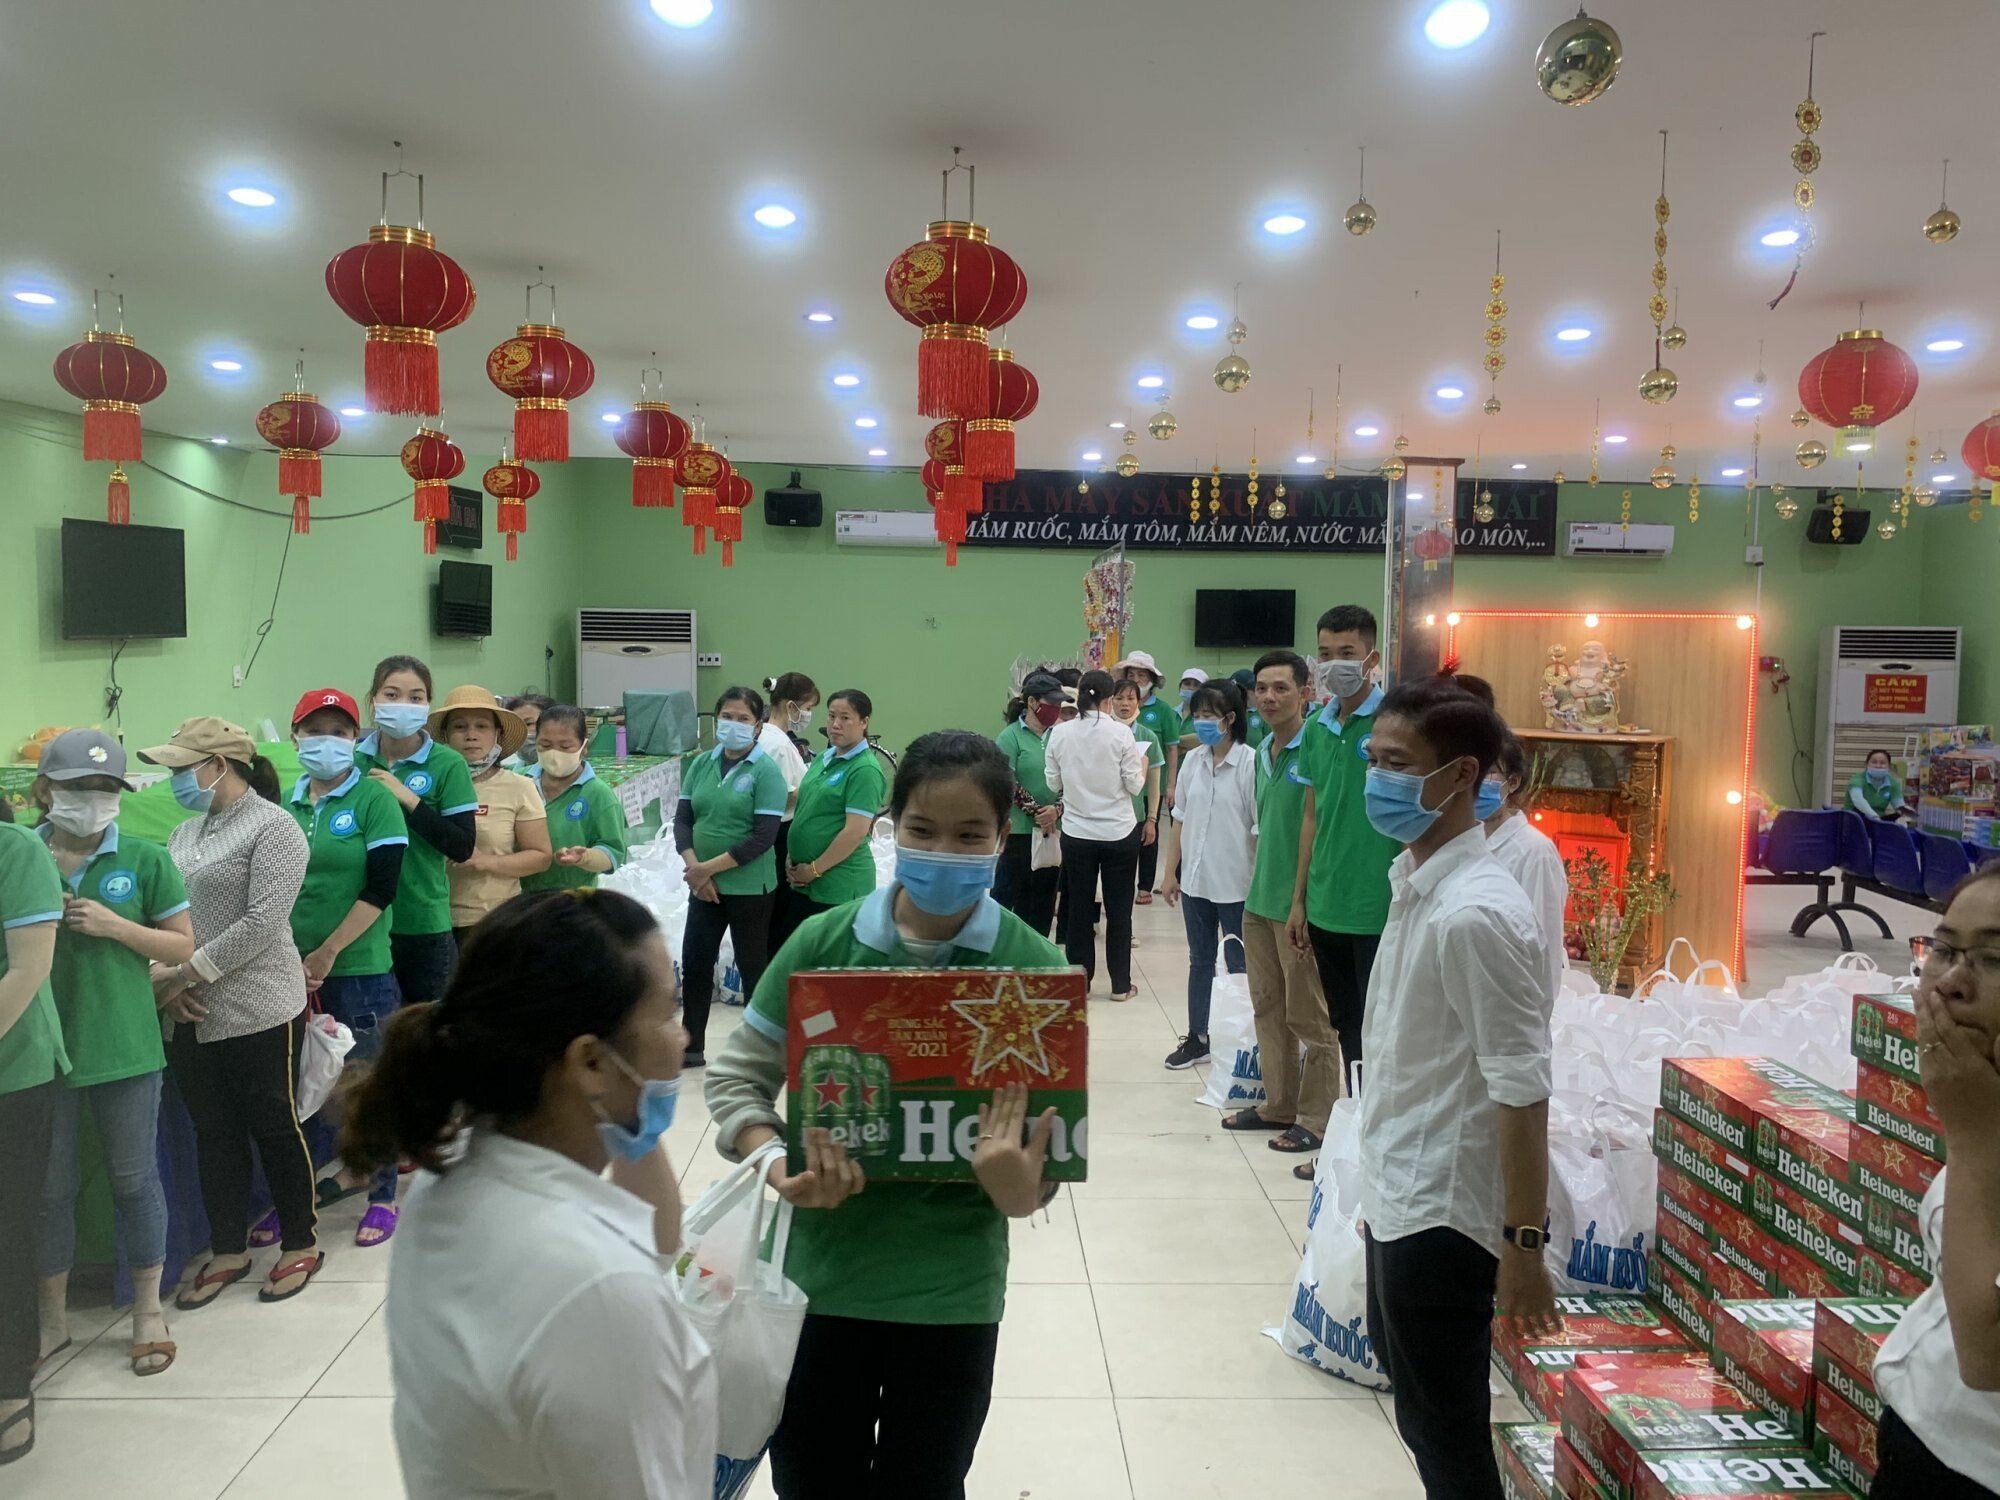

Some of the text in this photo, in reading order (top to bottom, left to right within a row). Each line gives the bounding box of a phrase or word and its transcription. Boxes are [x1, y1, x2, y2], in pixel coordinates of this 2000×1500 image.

[1009, 514, 1073, 545] RUỐC,
[1077, 515, 1129, 542] MẮM
[1133, 519, 1182, 546] TÔM,
[1186, 516, 1237, 543] MẮM
[1240, 520, 1291, 547] NÊM,
[1294, 520, 1354, 545] NƯỚC
[906, 1043, 950, 1057] 2021
[1884, 1034, 1920, 1074] Hei
[1679, 1089, 1745, 1149] Heineken
[1868, 1104, 1935, 1153] Heineken
[1674, 1141, 1743, 1204] Heineken
[1777, 1148, 1863, 1222] Heineken
[1663, 1194, 1705, 1235] Heineken
[1610, 1231, 1648, 1292] RUỐ
[1662, 1239, 1701, 1282] Heineken
[1720, 1238, 1766, 1285] Heineken
[1324, 1316, 1373, 1369] RUỐC
[1725, 1357, 1789, 1426] Heineken
[1828, 1362, 1883, 1421] Heinek
